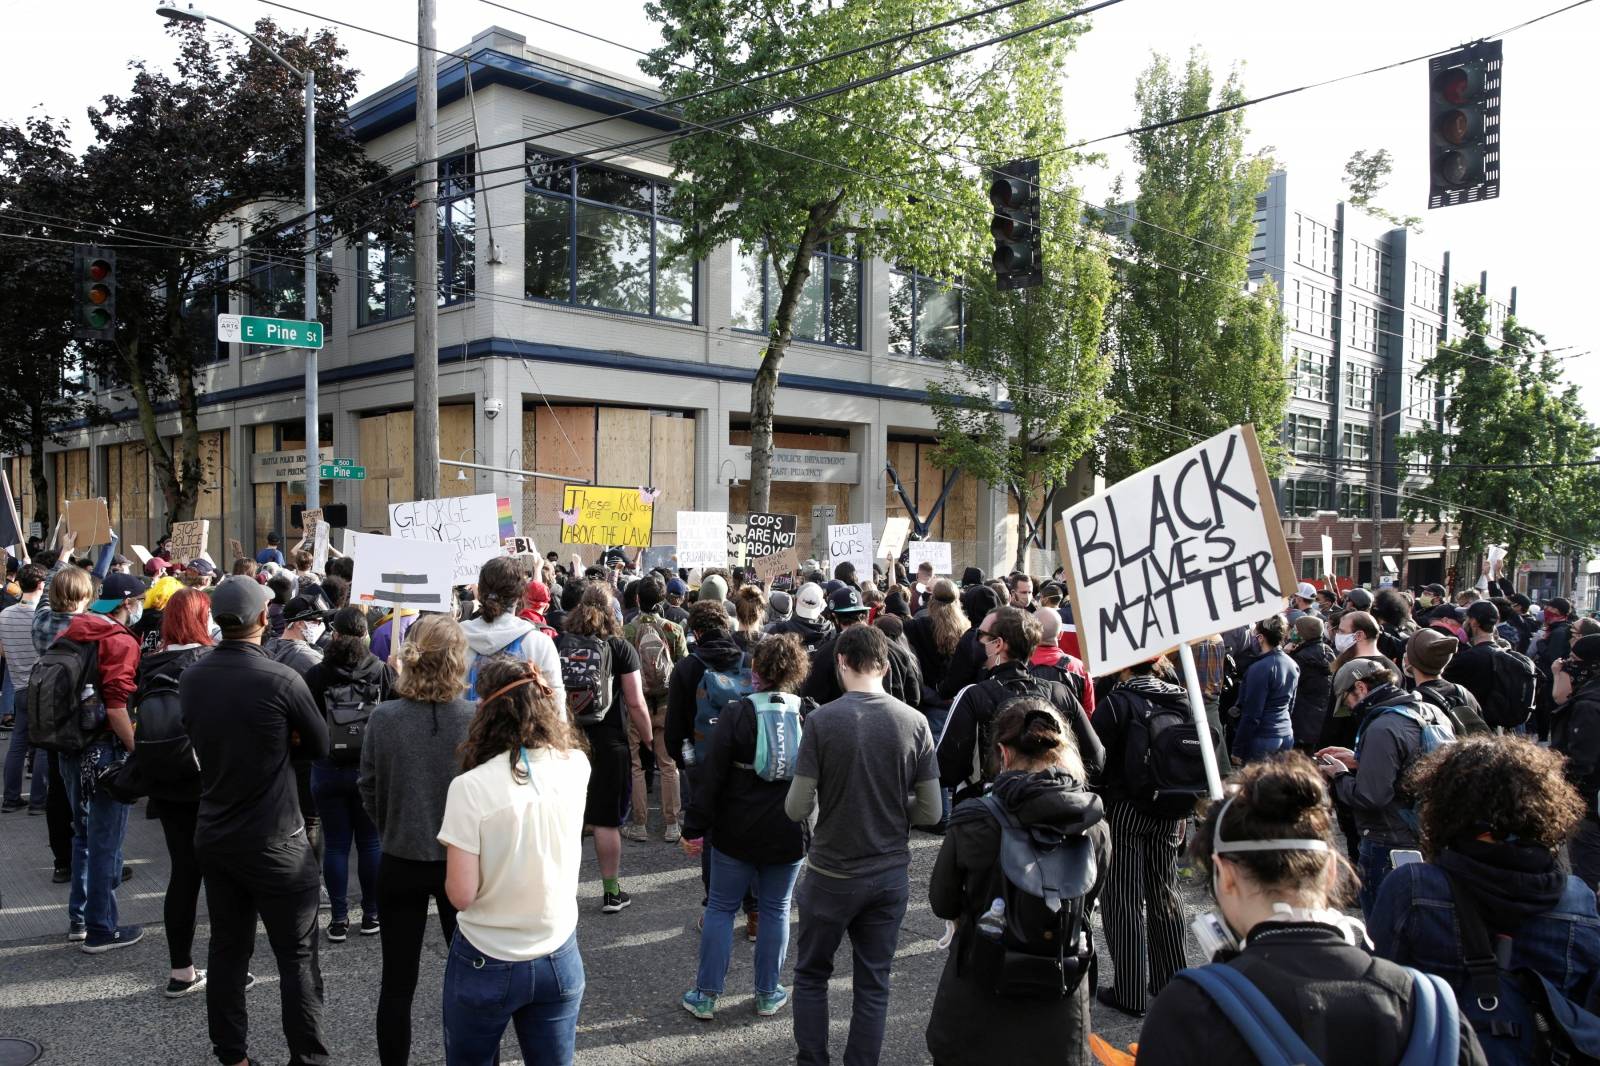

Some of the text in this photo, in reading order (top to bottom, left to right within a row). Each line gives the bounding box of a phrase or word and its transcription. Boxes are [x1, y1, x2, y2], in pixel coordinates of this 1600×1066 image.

[246, 324, 317, 342] E Pine St
[777, 453, 802, 463] POLICE
[804, 455, 846, 465] DEPARTMENT
[322, 468, 327, 476] E
[333, 467, 351, 477] Pine
[790, 467, 823, 477] PRECINCT
[567, 489, 611, 510] These
[394, 497, 471, 528] GEORGE
[586, 510, 632, 522] are not
[1070, 434, 1257, 587] BLACK
[177, 522, 199, 536] STOP
[750, 514, 782, 530] COPS
[564, 524, 651, 546] ABOVE THE LAW
[748, 528, 770, 542] ARE
[772, 532, 796, 546] NOT
[834, 525, 859, 538] HOLD
[172, 534, 203, 547] POLICE
[831, 540, 865, 557] COPS
[1114, 524, 1236, 610] LIVES
[849, 592, 858, 604] S
[1100, 550, 1282, 661] MATTER
[776, 722, 786, 779] NATHAN
